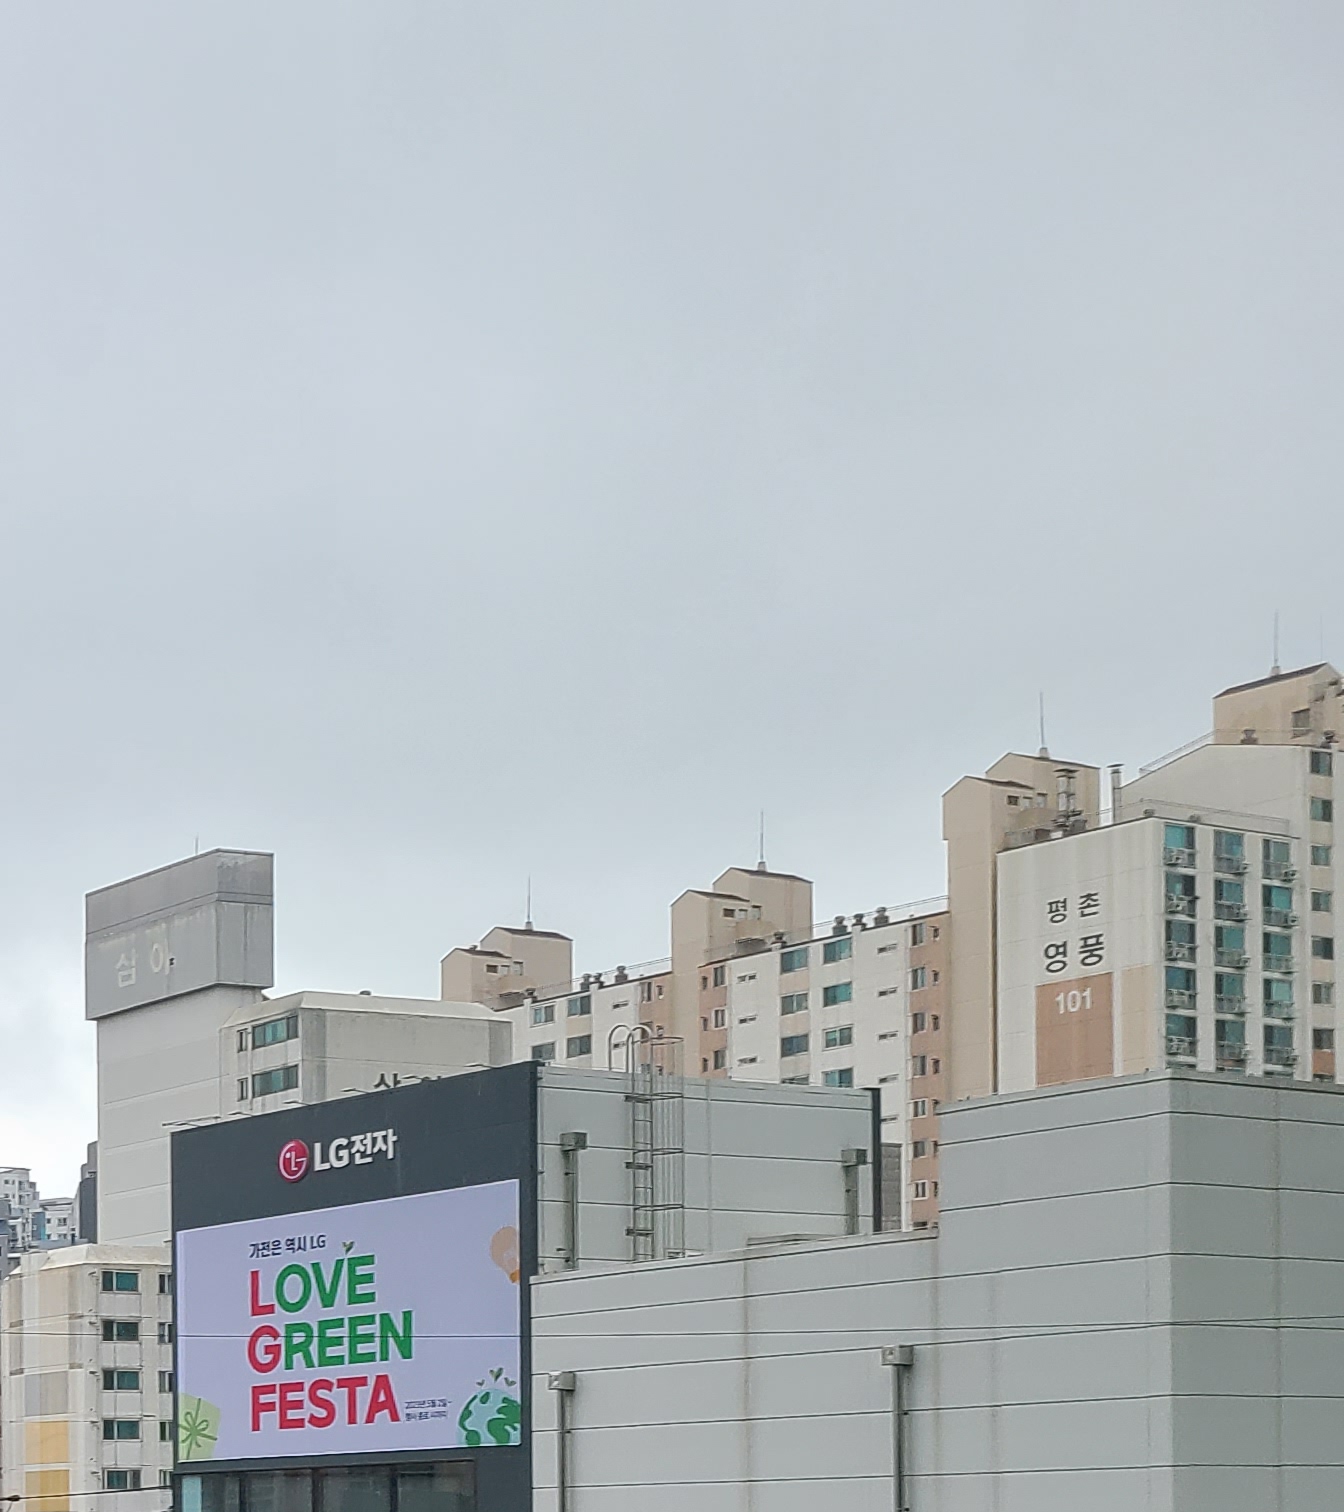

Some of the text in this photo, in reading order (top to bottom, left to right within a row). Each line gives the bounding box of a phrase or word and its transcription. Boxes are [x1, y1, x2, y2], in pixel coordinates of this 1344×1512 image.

[1047, 892, 1101, 924] 평촌
[1044, 933, 1105, 973] 영풍
[1055, 988, 1092, 1014] 101
[313, 1128, 398, 1172] LG전자
[249, 1234, 327, 1258] 가전은 역시 LG
[249, 1254, 376, 1317] LOVE
[247, 1309, 413, 1374] GREEN
[250, 1374, 401, 1432] FESTA
